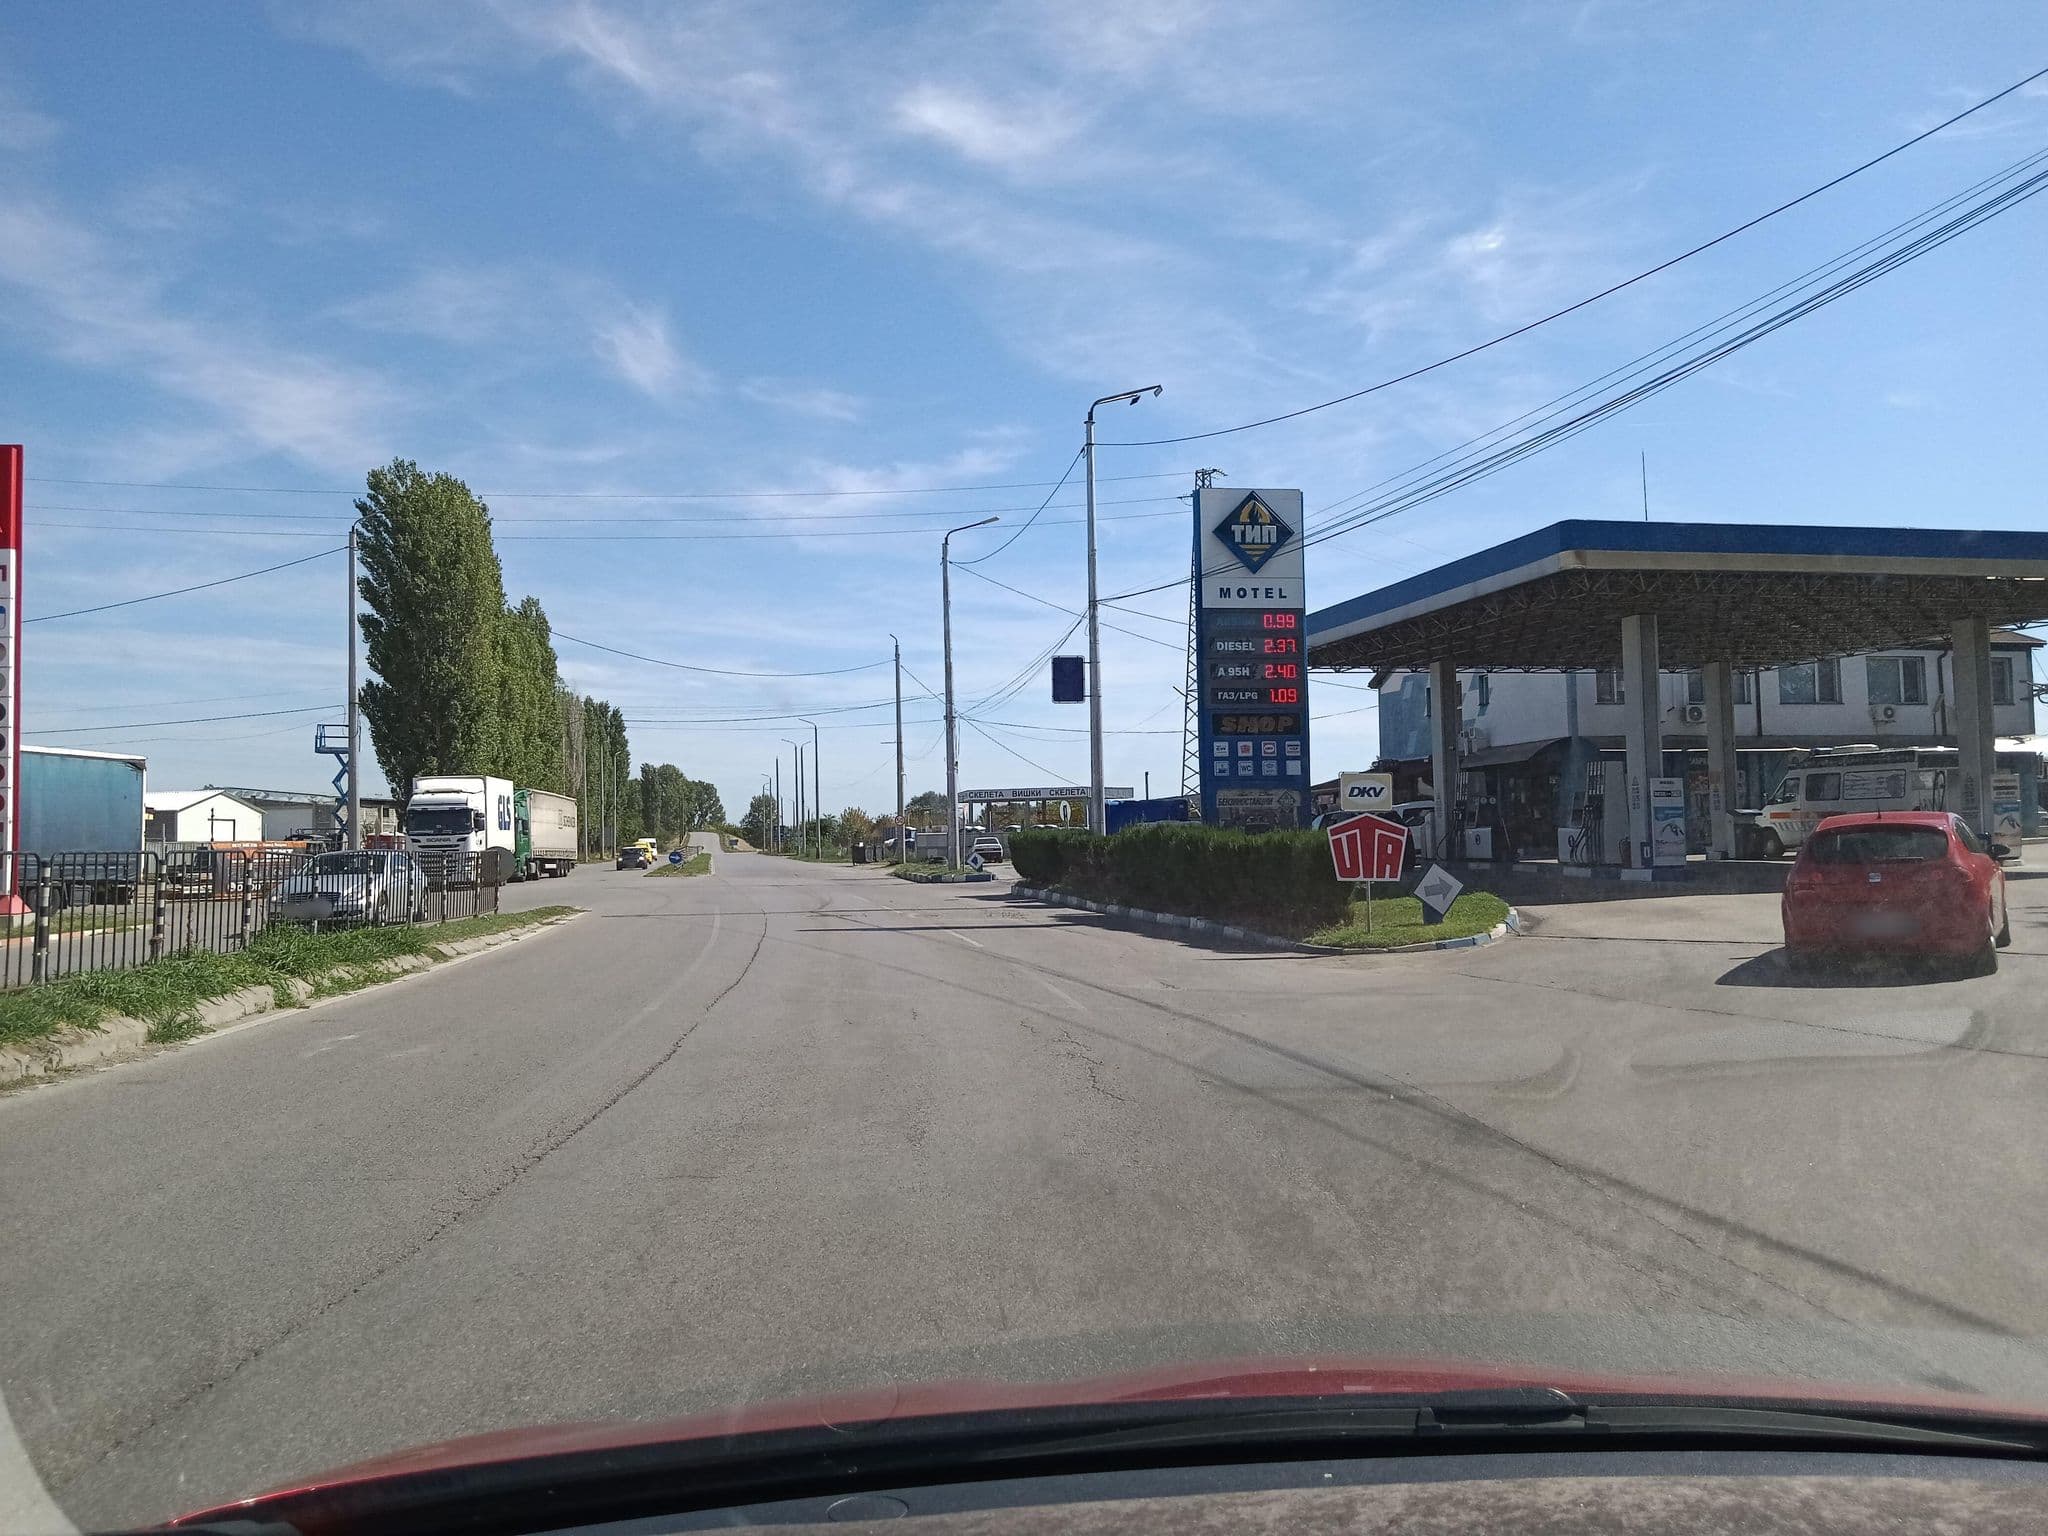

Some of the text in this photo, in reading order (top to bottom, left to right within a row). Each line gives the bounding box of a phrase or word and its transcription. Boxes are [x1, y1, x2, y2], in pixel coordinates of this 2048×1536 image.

[1231, 525, 1277, 543] ТИП
[1219, 587, 1287, 599] MOTEL
[1264, 614, 1295, 628] 0.99
[1216, 639, 1296, 653] DIESEL 2.37
[1265, 664, 1296, 678] 2.40
[1217, 688, 1297, 702] ГАЗ/LPG 1.09
[1221, 715, 1294, 733] SHOP
[968, 788, 1086, 799] СКЕЛЕТА ВИШКИ СКЕЛЕТА
[1348, 786, 1385, 798] DKV
[498, 795, 511, 831] GLS
